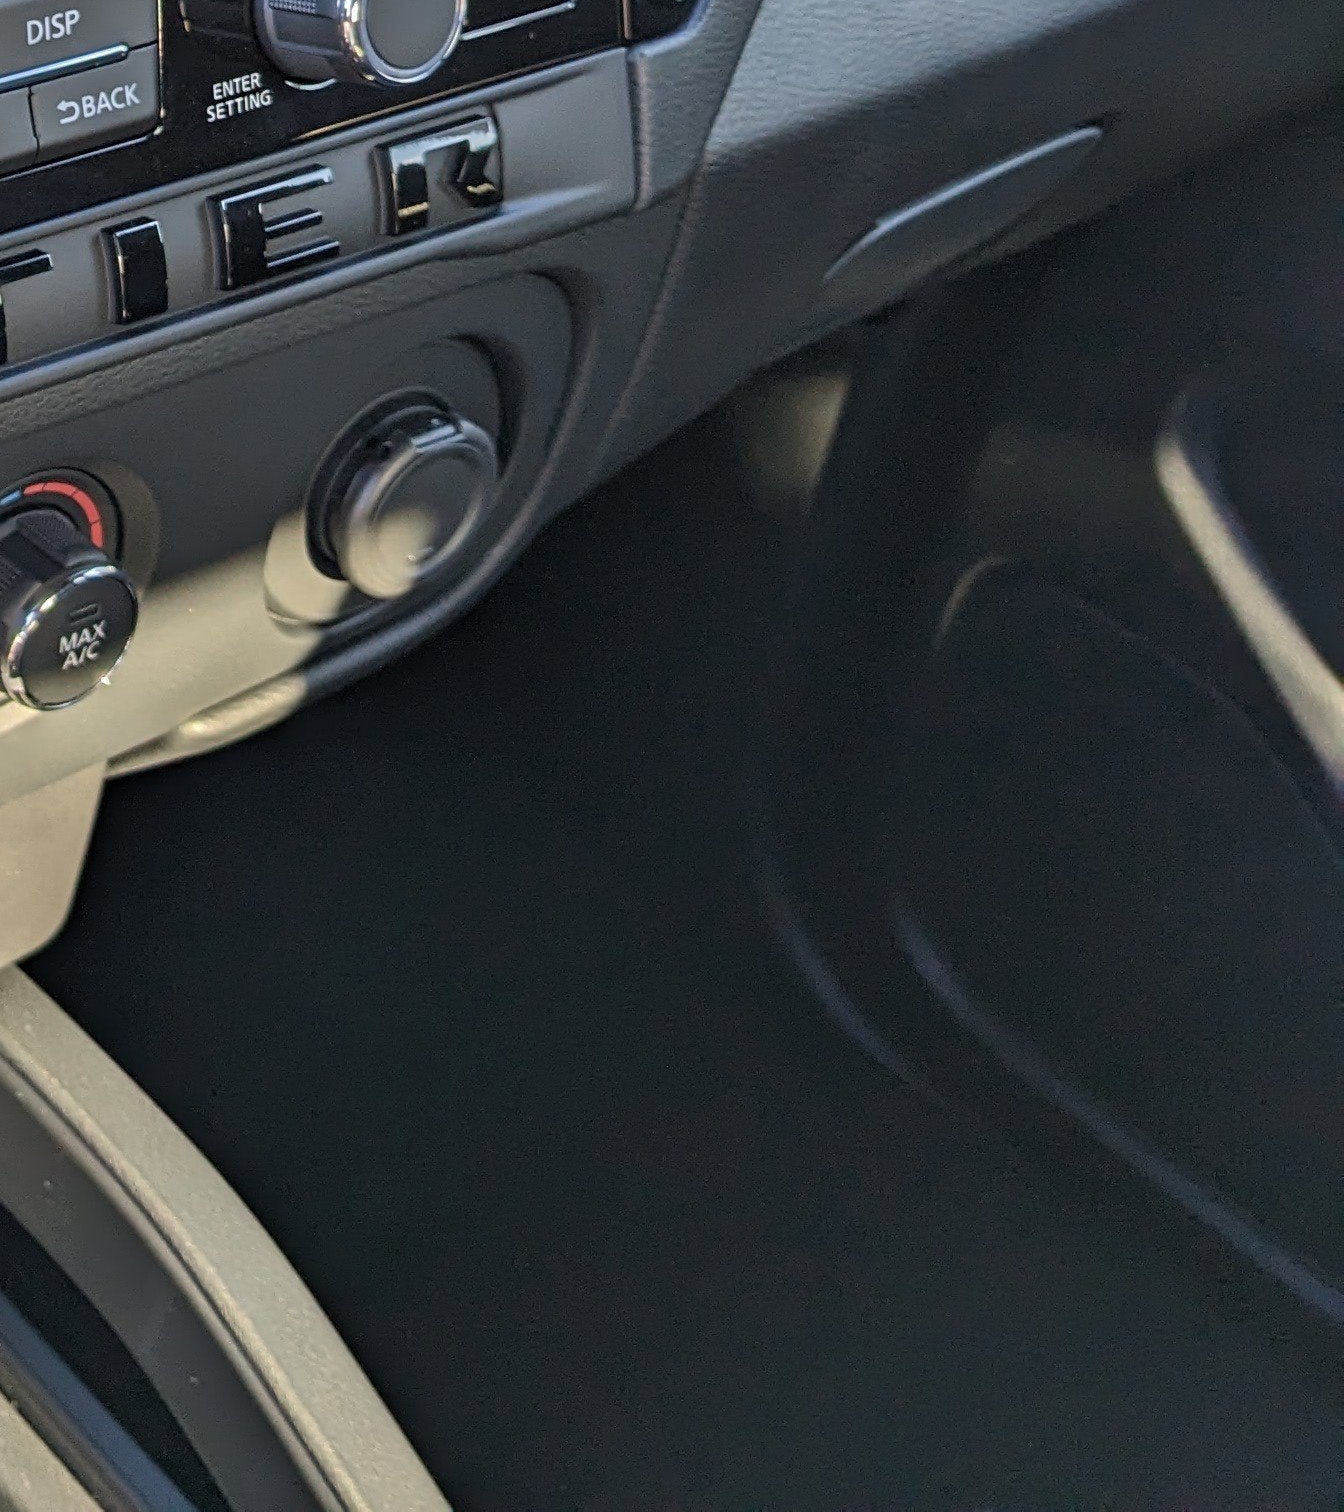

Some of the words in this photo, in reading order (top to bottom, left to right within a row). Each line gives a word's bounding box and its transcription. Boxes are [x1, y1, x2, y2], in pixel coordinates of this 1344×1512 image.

[25, 9, 81, 47] DISP
[81, 83, 141, 120] BACK
[212, 71, 262, 101] ENTER
[206, 88, 274, 123] SETTING
[59, 619, 107, 654] MAX
[61, 642, 100, 671] A/C
